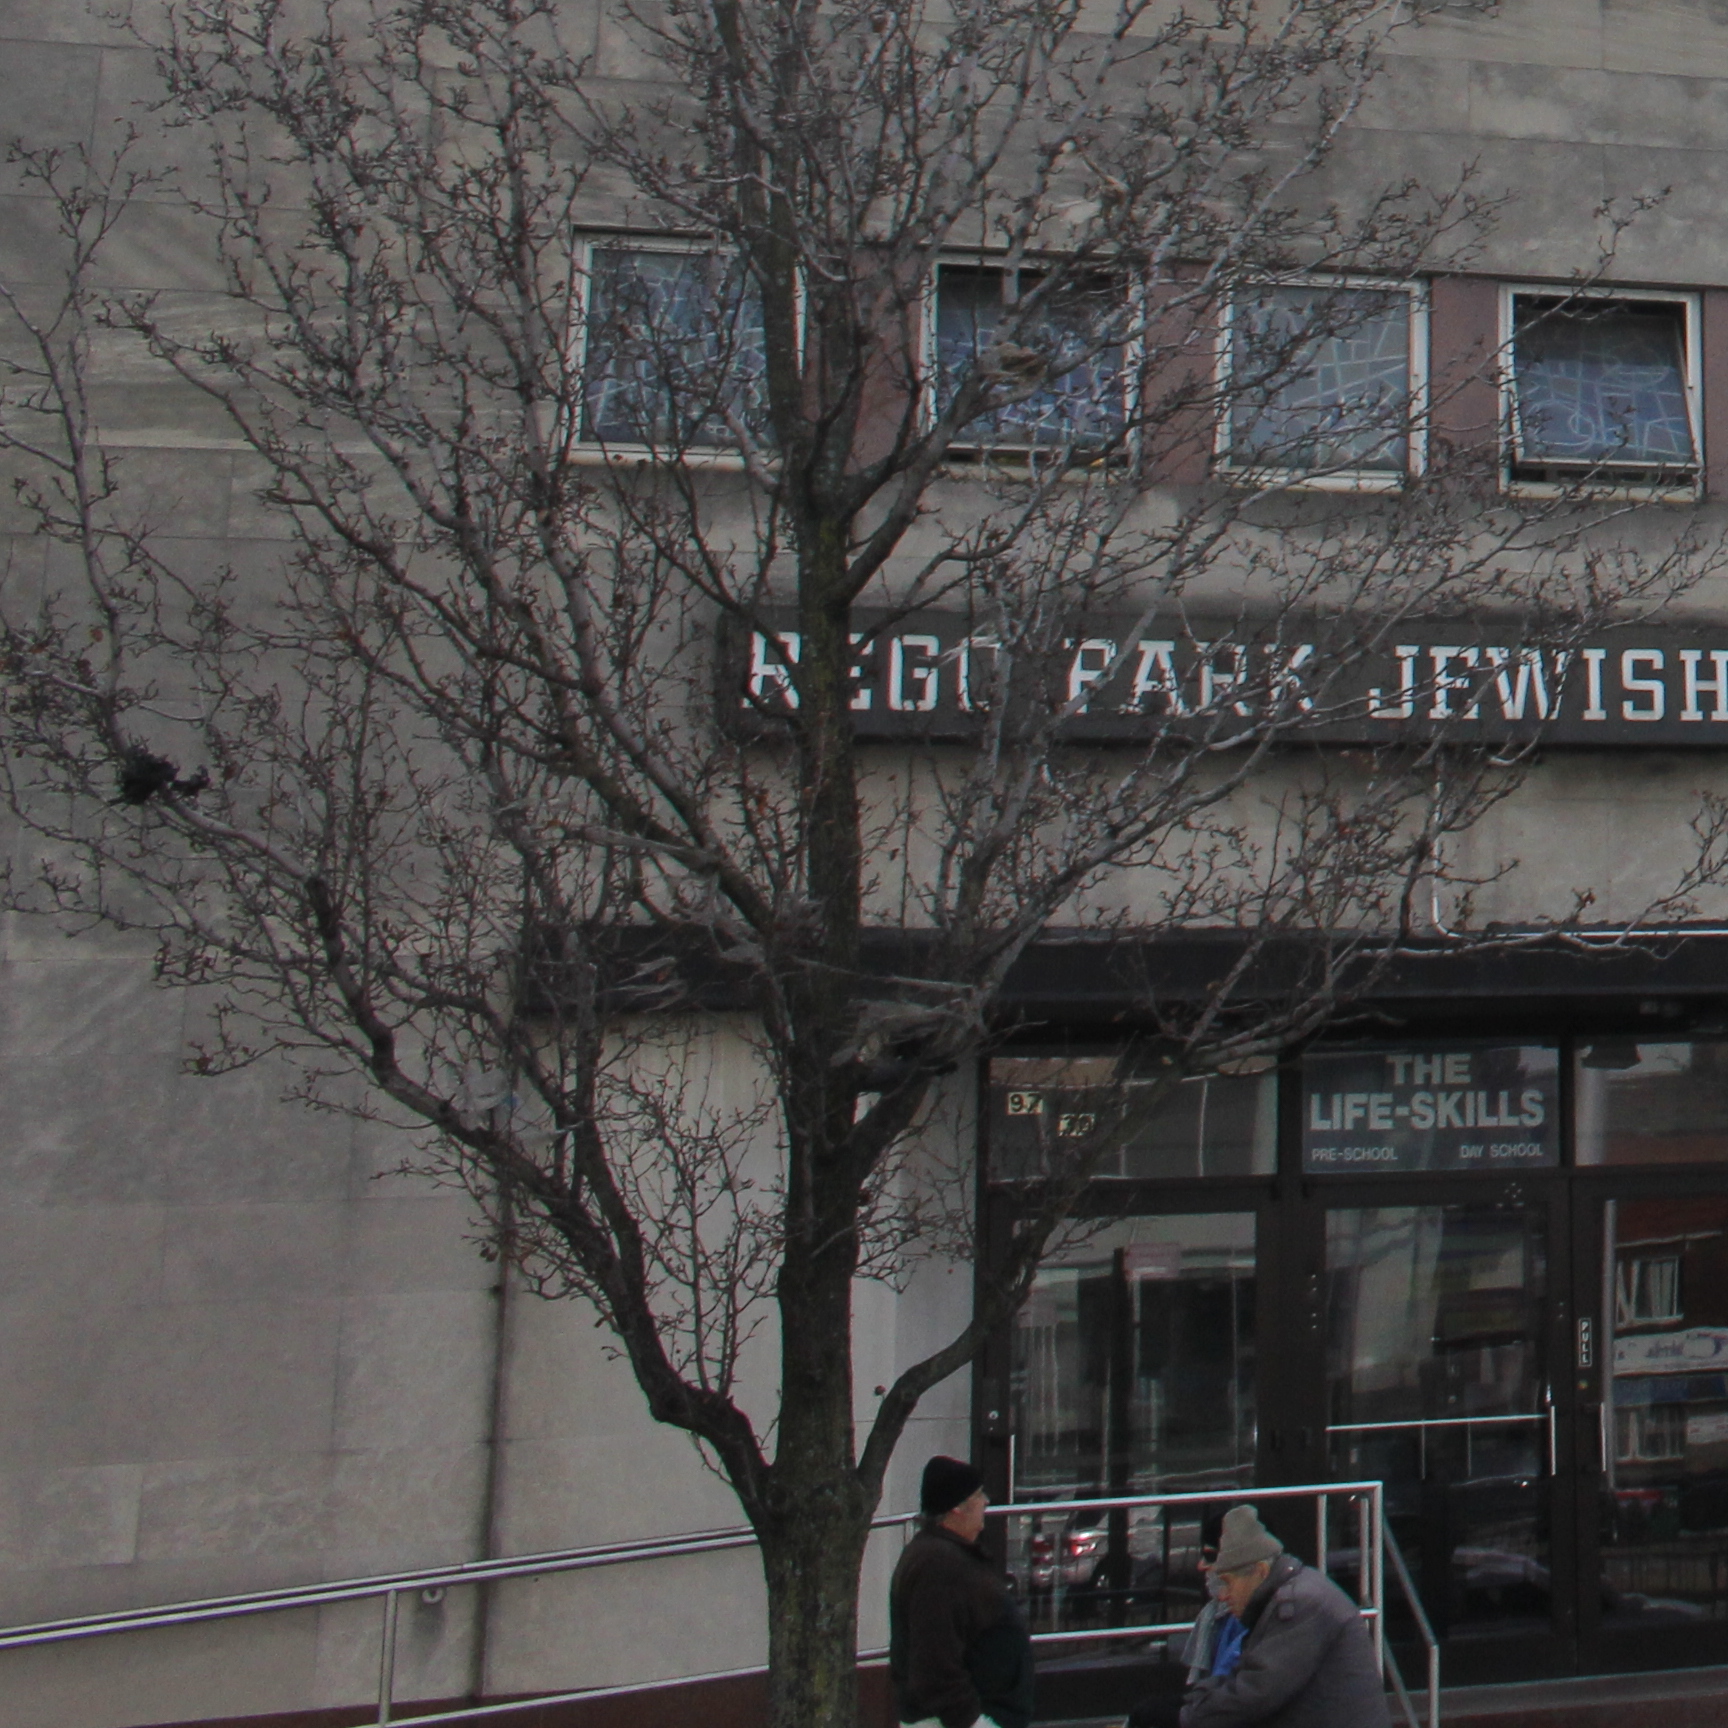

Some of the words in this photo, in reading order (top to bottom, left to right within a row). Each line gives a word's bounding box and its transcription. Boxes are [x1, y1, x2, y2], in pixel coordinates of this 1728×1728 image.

[1064, 637, 1314, 717] PARK
[1386, 1053, 1472, 1086] THE
[1010, 1094, 1043, 1113] 97
[1310, 1089, 1546, 1131] LIFE-SKILLS
[1311, 1146, 1399, 1163] PRE-SCHOOL
[1459, 1144, 1484, 1159] DAY
[1490, 1142, 1544, 1158] SCHOOL
[1581, 1320, 1590, 1363] PULL
